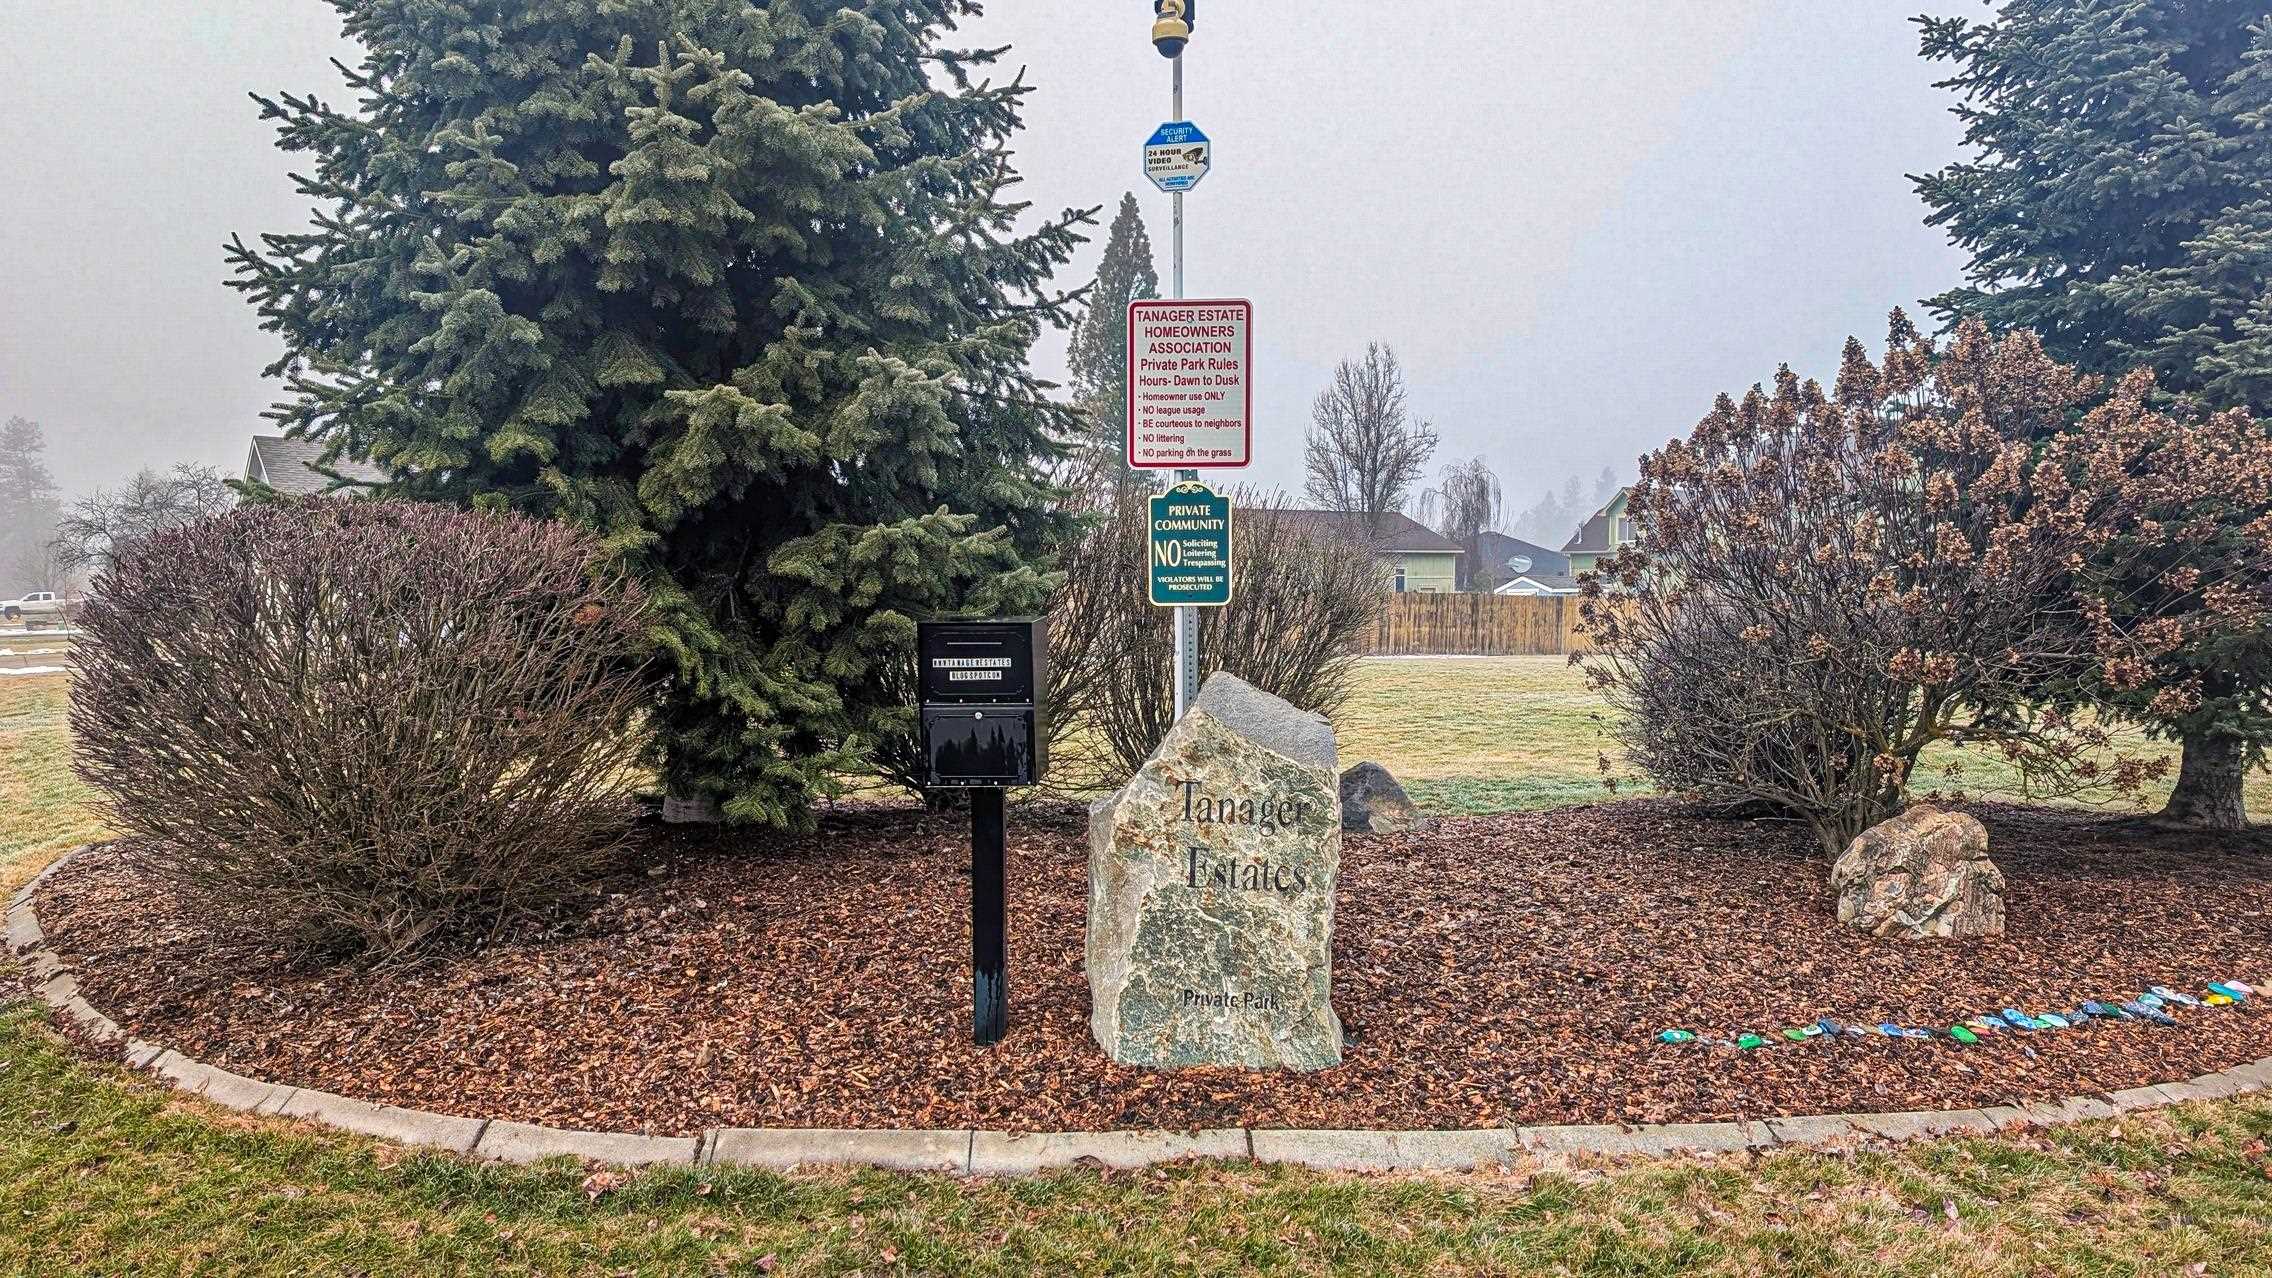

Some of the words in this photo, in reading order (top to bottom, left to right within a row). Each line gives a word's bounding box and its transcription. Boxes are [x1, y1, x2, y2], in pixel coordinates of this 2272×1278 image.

[1160, 127, 1193, 136] SECURITY
[1166, 135, 1187, 143] ALERT
[1159, 148, 1182, 156] HOUR
[1148, 157, 1172, 165] VIDEO
[1148, 164, 1189, 172] SURVEILLANCE
[1136, 310, 1195, 322] TANAGER
[1198, 309, 1244, 321] ESTATE
[1144, 325, 1235, 338] HOMEOWNERS
[1149, 341, 1232, 354] ASSOCIATION
[1140, 358, 1178, 370] Private
[1181, 358, 1205, 370] Park
[1208, 357, 1239, 370] Rules
[1139, 375, 1172, 386] Hours-
[1174, 375, 1200, 386] Dawn
[1203, 375, 1213, 385] to
[1215, 374, 1240, 385] Dusk
[1142, 391, 1188, 401] Homeowner
[1188, 393, 1202, 401] use
[1204, 391, 1226, 400] ONLY
[1142, 405, 1155, 415] NO
[1156, 406, 1181, 416] league
[1183, 407, 1206, 416] usage
[1142, 419, 1153, 428] BE
[1155, 419, 1193, 428] courteous
[1194, 419, 1202, 428] to
[1204, 418, 1242, 429] neighbors
[1142, 433, 1155, 443] NO
[1156, 433, 1185, 444] littering
[1142, 448, 1155, 457] NO
[1156, 448, 1184, 459] parking
[1186, 448, 1196, 457] on
[1197, 447, 1210, 457] the
[1211, 448, 1232, 459] grass
[1168, 505, 1211, 517] PRIVATE
[1154, 519, 1225, 531] COMMUNITY
[1183, 539, 1219, 549] Soliciting
[1154, 539, 1182, 568] NO
[1183, 549, 1217, 558] Loitering
[1183, 559, 1227, 569] Trespassing
[1157, 575, 1196, 584] VIOLATORS
[1197, 575, 1214, 583] WILL
[1215, 575, 1224, 583] BE
[1176, 780, 1312, 838] Tanager
[1186, 846, 1308, 893] Estates
[1183, 989, 1239, 1008] Private
[1243, 991, 1280, 1010] Park
